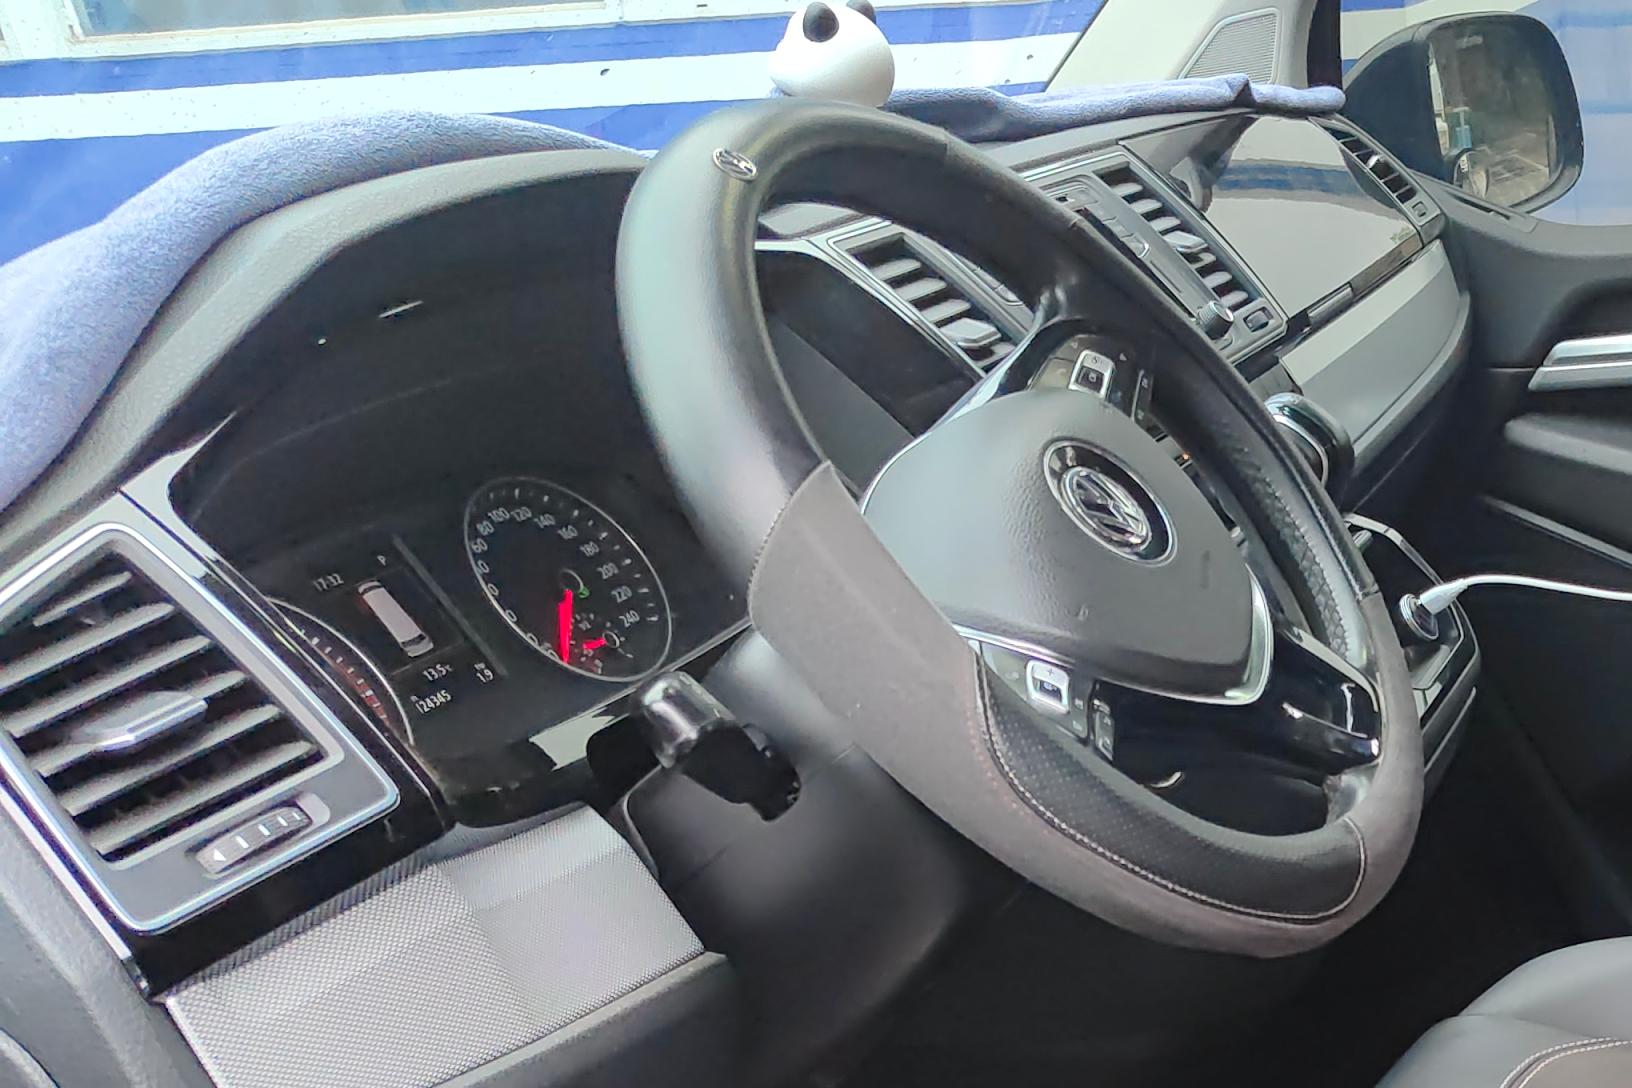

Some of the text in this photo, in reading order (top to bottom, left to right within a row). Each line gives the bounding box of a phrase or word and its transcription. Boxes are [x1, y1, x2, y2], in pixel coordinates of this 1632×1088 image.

[488, 507, 510, 522] 100
[510, 506, 532, 522] 120
[533, 514, 555, 529] 140
[476, 521, 494, 535] 80
[557, 525, 578, 540] 160
[471, 538, 488, 552] 60
[377, 554, 387, 566] P
[597, 563, 618, 579] 200
[611, 586, 632, 602] 220
[618, 610, 640, 627] 240
[415, 689, 452, 714] 124345
